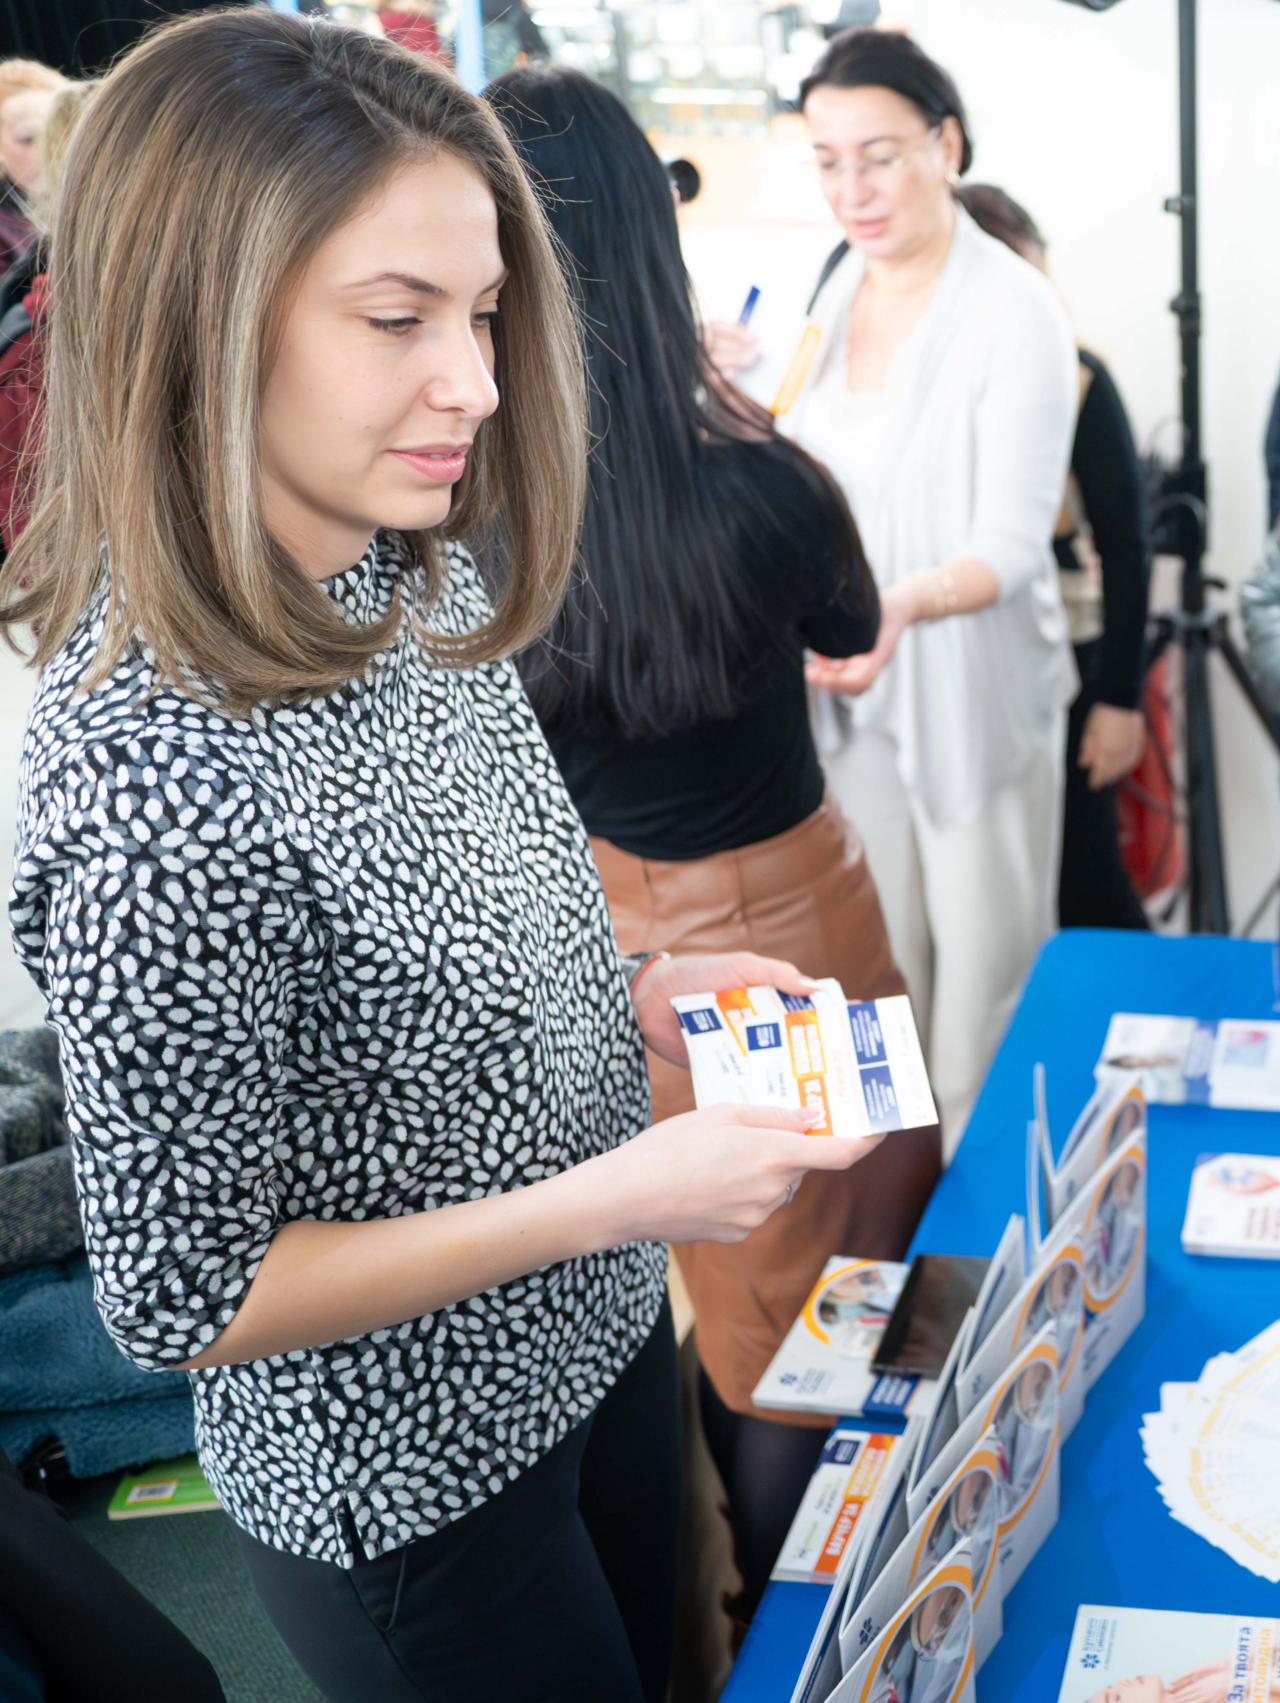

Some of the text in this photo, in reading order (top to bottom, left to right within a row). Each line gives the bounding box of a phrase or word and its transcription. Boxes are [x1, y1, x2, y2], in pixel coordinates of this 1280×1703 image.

[1227, 1627, 1252, 1702] За твоята
[1253, 1628, 1275, 1703] итовидна
